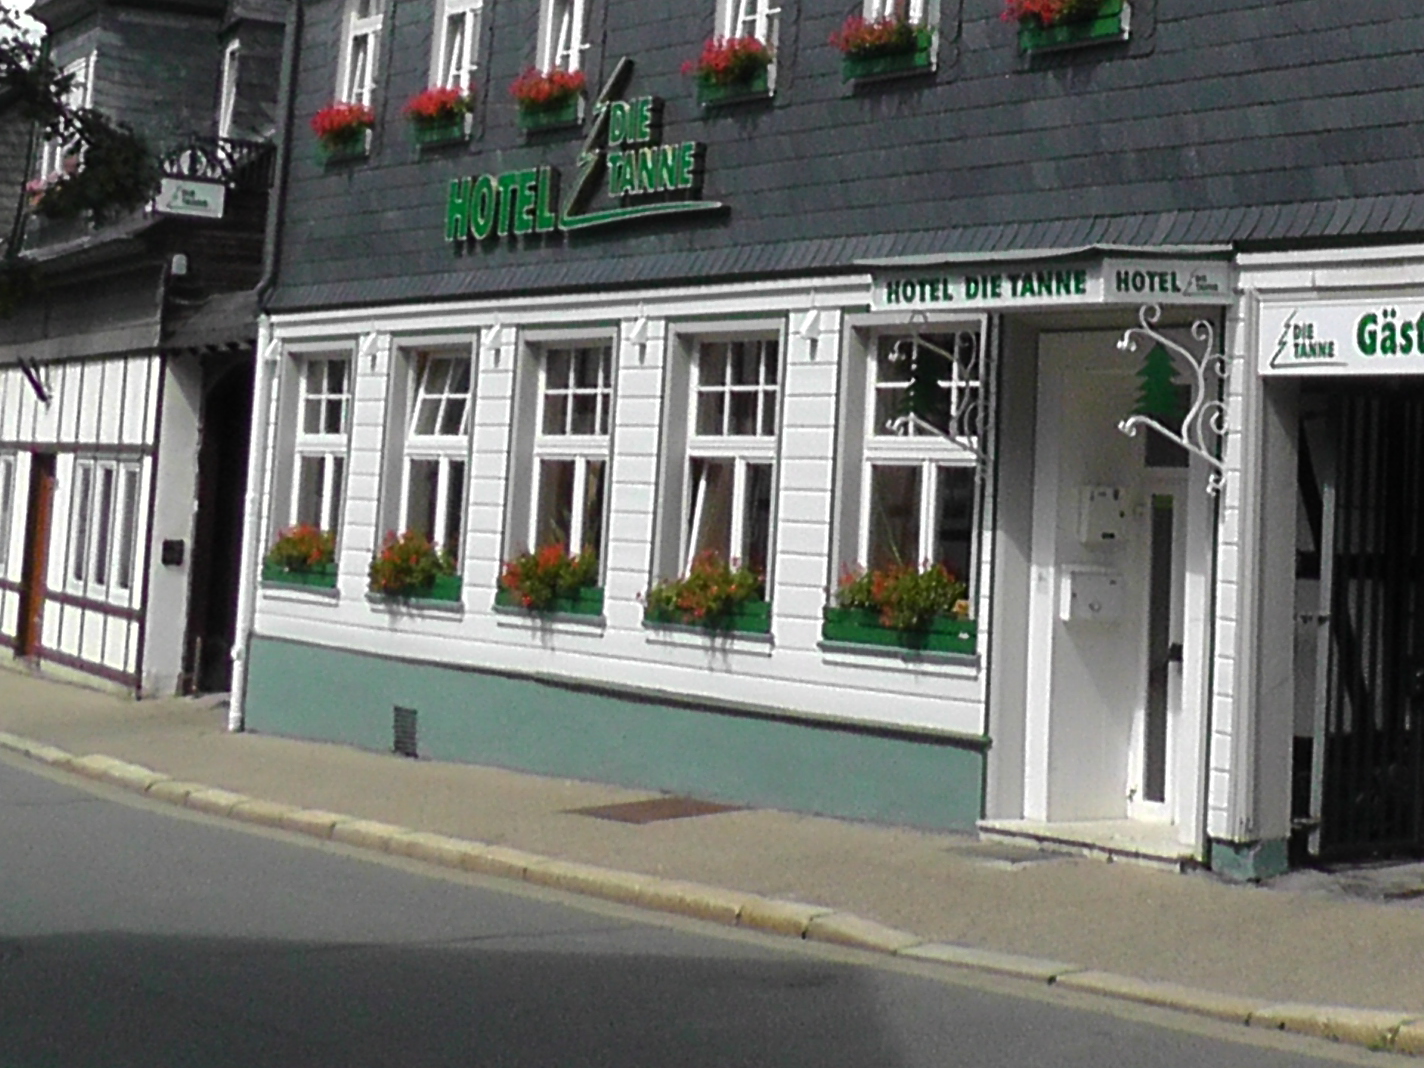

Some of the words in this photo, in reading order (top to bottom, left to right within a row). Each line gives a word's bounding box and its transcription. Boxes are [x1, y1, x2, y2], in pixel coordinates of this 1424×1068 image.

[607, 95, 654, 146] DIE
[607, 141, 697, 197] TANNE
[445, 165, 556, 241] HOTEL
[886, 277, 954, 304] HOTEL
[965, 275, 1002, 300] DIE
[1007, 269, 1087, 298] TANNE
[1115, 270, 1182, 293] HOTEL
[1293, 323, 1314, 340] DIE
[1293, 340, 1335, 359] TANNE
